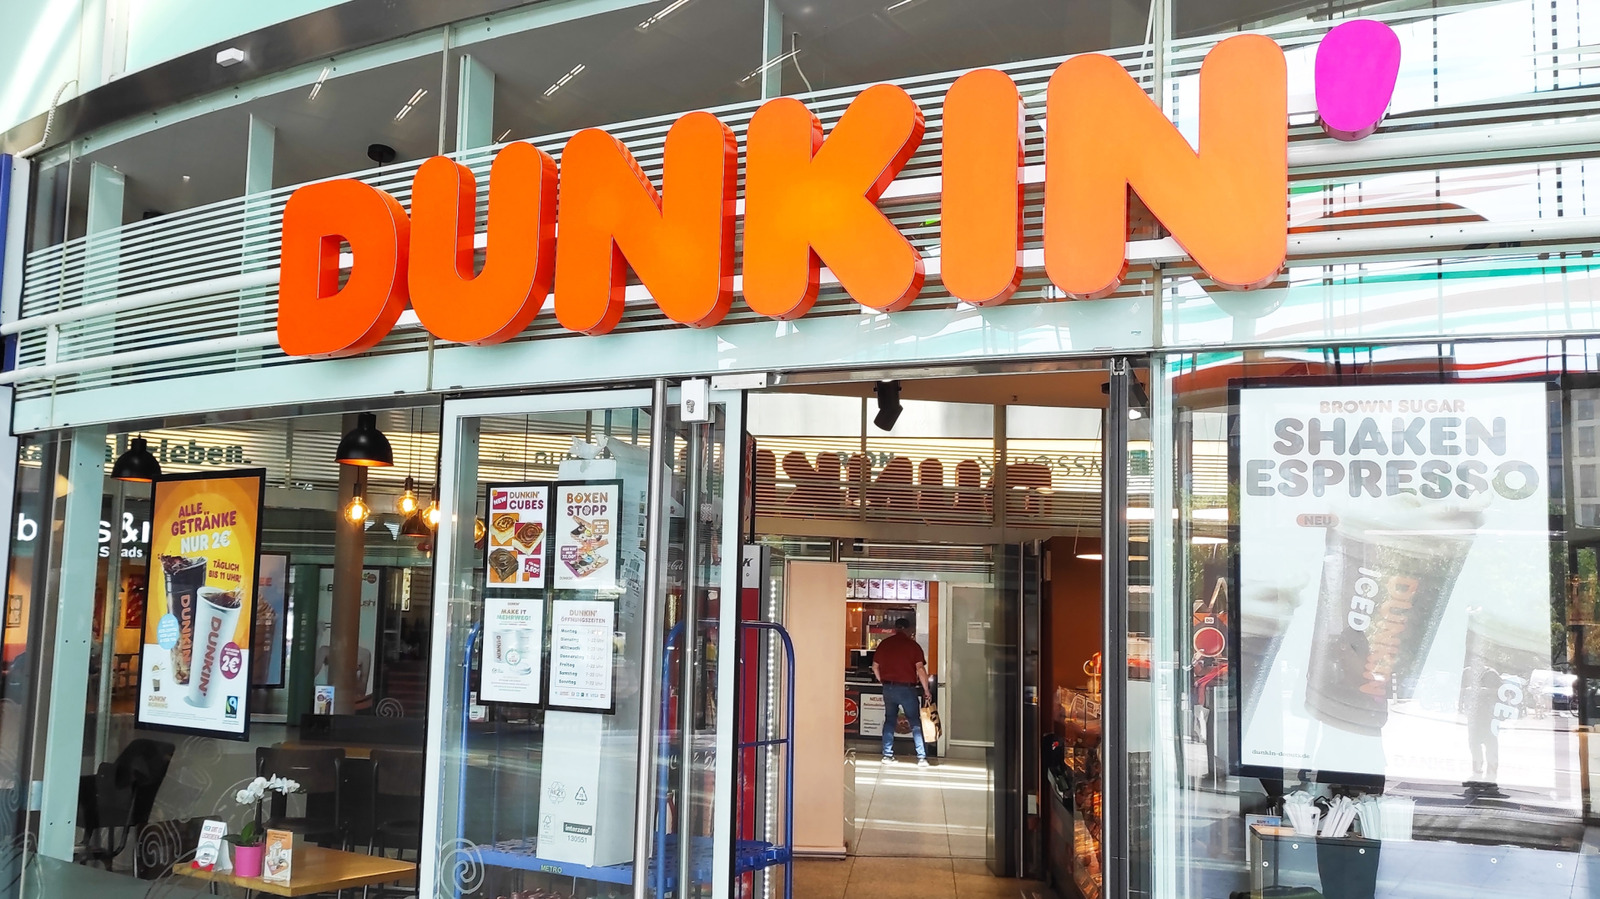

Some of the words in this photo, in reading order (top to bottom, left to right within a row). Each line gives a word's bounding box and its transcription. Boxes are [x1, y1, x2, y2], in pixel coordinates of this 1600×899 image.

[277, 19, 1402, 358] DUNKIN'
[1319, 400, 1392, 413] BROWN
[1399, 399, 1465, 413] SUGAR
[1273, 416, 1506, 456] SHAKEN
[1246, 459, 1540, 500] ESPRESSO
[493, 496, 506, 505] NEW
[510, 491, 539, 499] DUNKIN'
[566, 492, 608, 504] BOXEN
[178, 503, 203, 518] ALLE
[509, 500, 544, 510] CUBES
[567, 505, 607, 516] STOPP
[171, 510, 237, 536] GETRÄNKE
[1304, 516, 1332, 526] NEU
[181, 533, 209, 554] NUR
[211, 530, 231, 549] 2€
[213, 559, 240, 572] TÄGLICH
[208, 570, 218, 579] BIS
[219, 571, 226, 579] 11
[227, 573, 242, 583] UHR!
[1347, 566, 1382, 632] ICED
[560, 616, 606, 624] ÖFFNUNGSZEITEN
[198, 616, 222, 697] DUNKIN'
[221, 655, 240, 673] 2€
[567, 835, 588, 843] 130551
[541, 864, 563, 874] METRO
